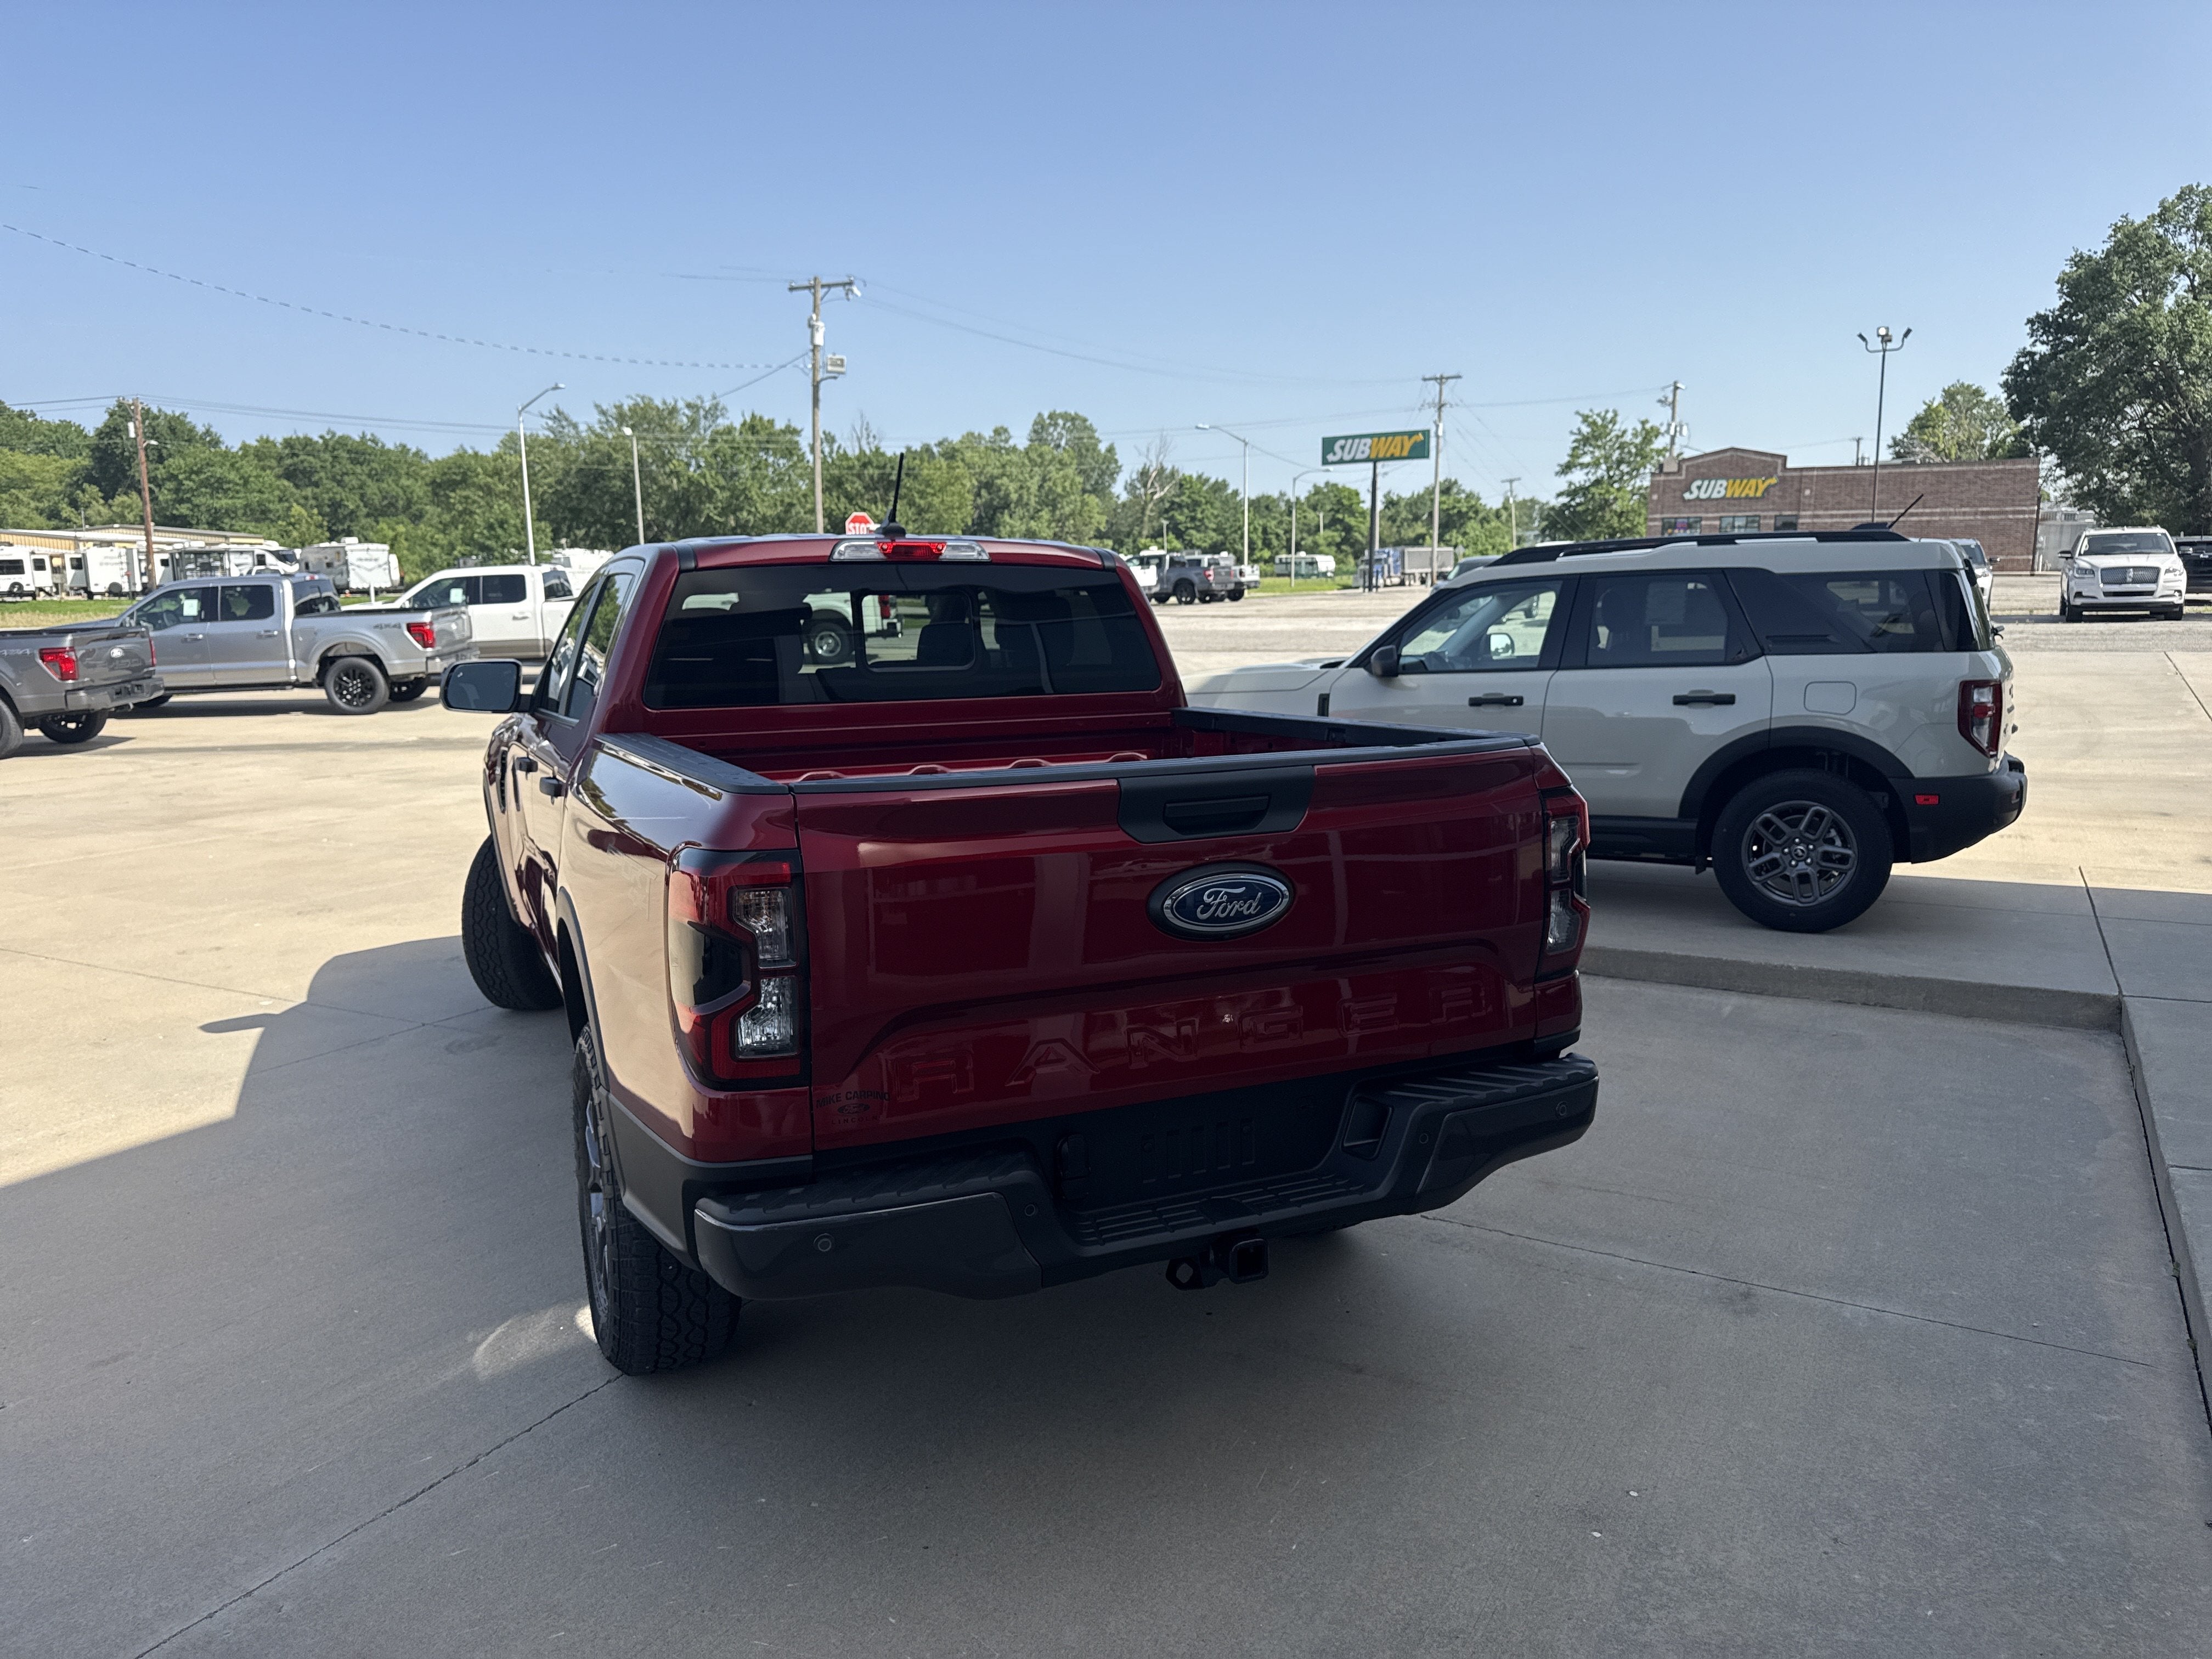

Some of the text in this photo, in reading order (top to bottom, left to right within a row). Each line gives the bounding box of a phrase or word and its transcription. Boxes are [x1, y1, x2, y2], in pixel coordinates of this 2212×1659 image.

[1327, 432, 1424, 462] SUBWAY
[1683, 475, 1778, 500] SUBWAY
[1197, 886, 1262, 921] Ford
[893, 984, 1490, 1102] RANGER
[816, 1090, 891, 1109] MIKE CARPINO
[831, 1115, 878, 1125] LINCOLN
